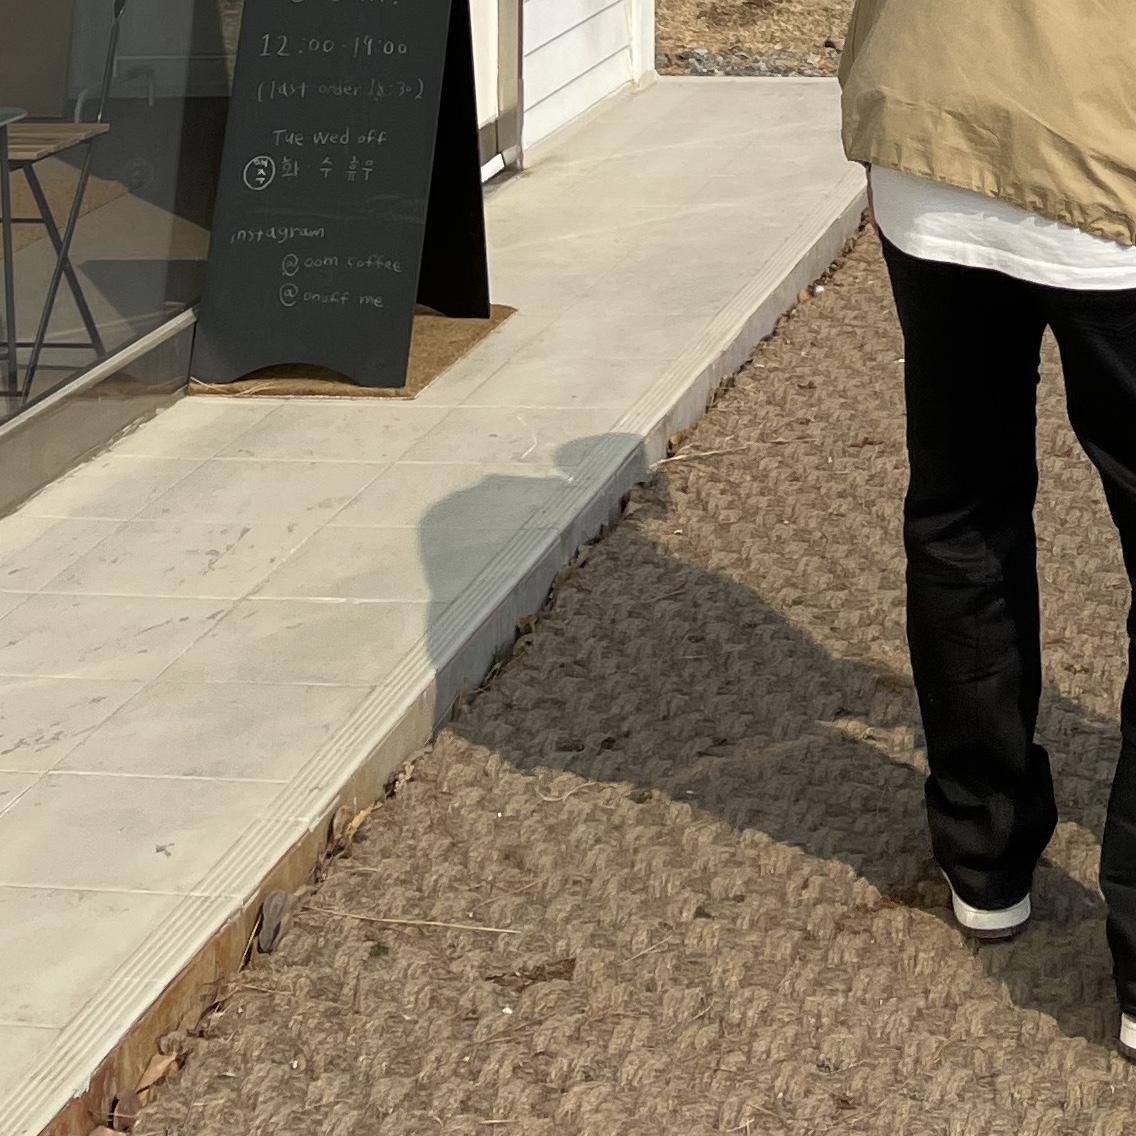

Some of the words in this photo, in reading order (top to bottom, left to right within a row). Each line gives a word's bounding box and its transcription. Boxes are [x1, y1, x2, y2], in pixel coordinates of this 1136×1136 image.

[318, 79, 361, 97] order
[272, 129, 304, 147] Tue
[357, 129, 388, 145] off
[319, 156, 333, 179] 수
[345, 155, 374, 182] 휴무
